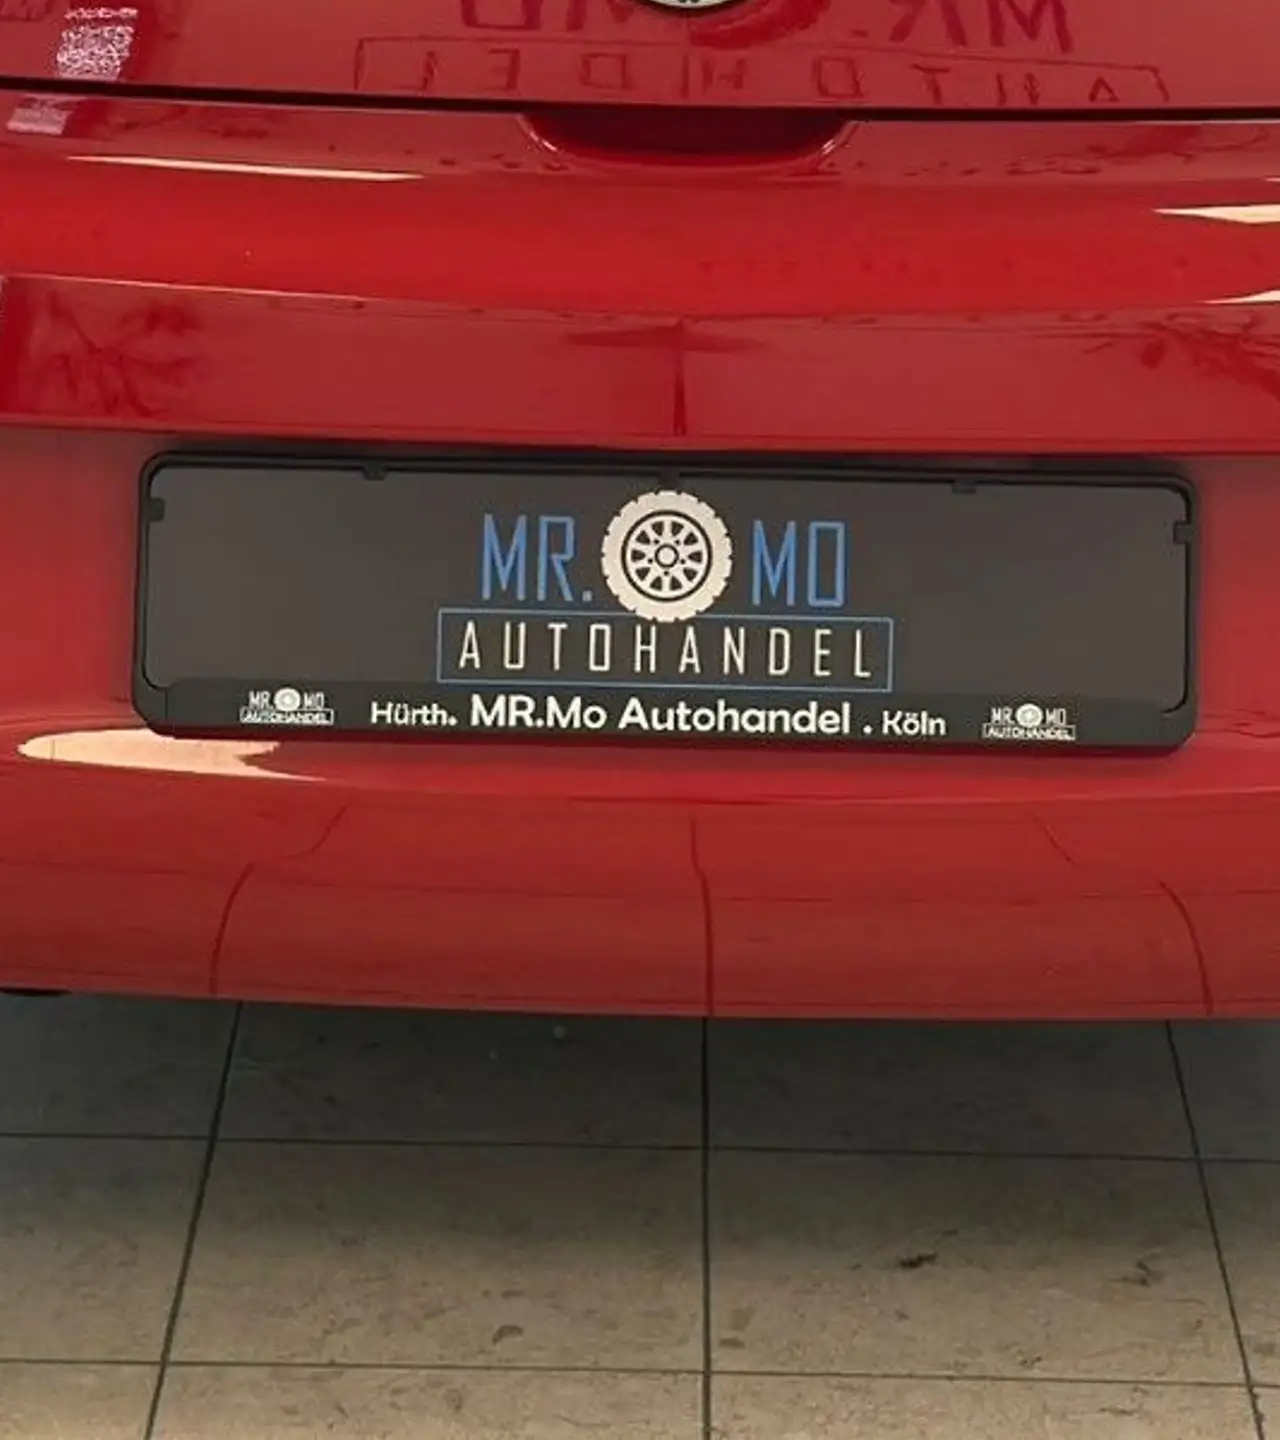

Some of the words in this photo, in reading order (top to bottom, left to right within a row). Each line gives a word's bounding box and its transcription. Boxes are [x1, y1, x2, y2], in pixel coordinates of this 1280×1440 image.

[482, 513, 593, 602] MR.
[751, 519, 846, 607] MO
[459, 620, 872, 679] AUTOHANDEL
[371, 701, 458, 727] Hürth.
[471, 693, 608, 729] MR.Mo
[619, 696, 850, 735] Autohandel
[882, 710, 947, 737] Köln
